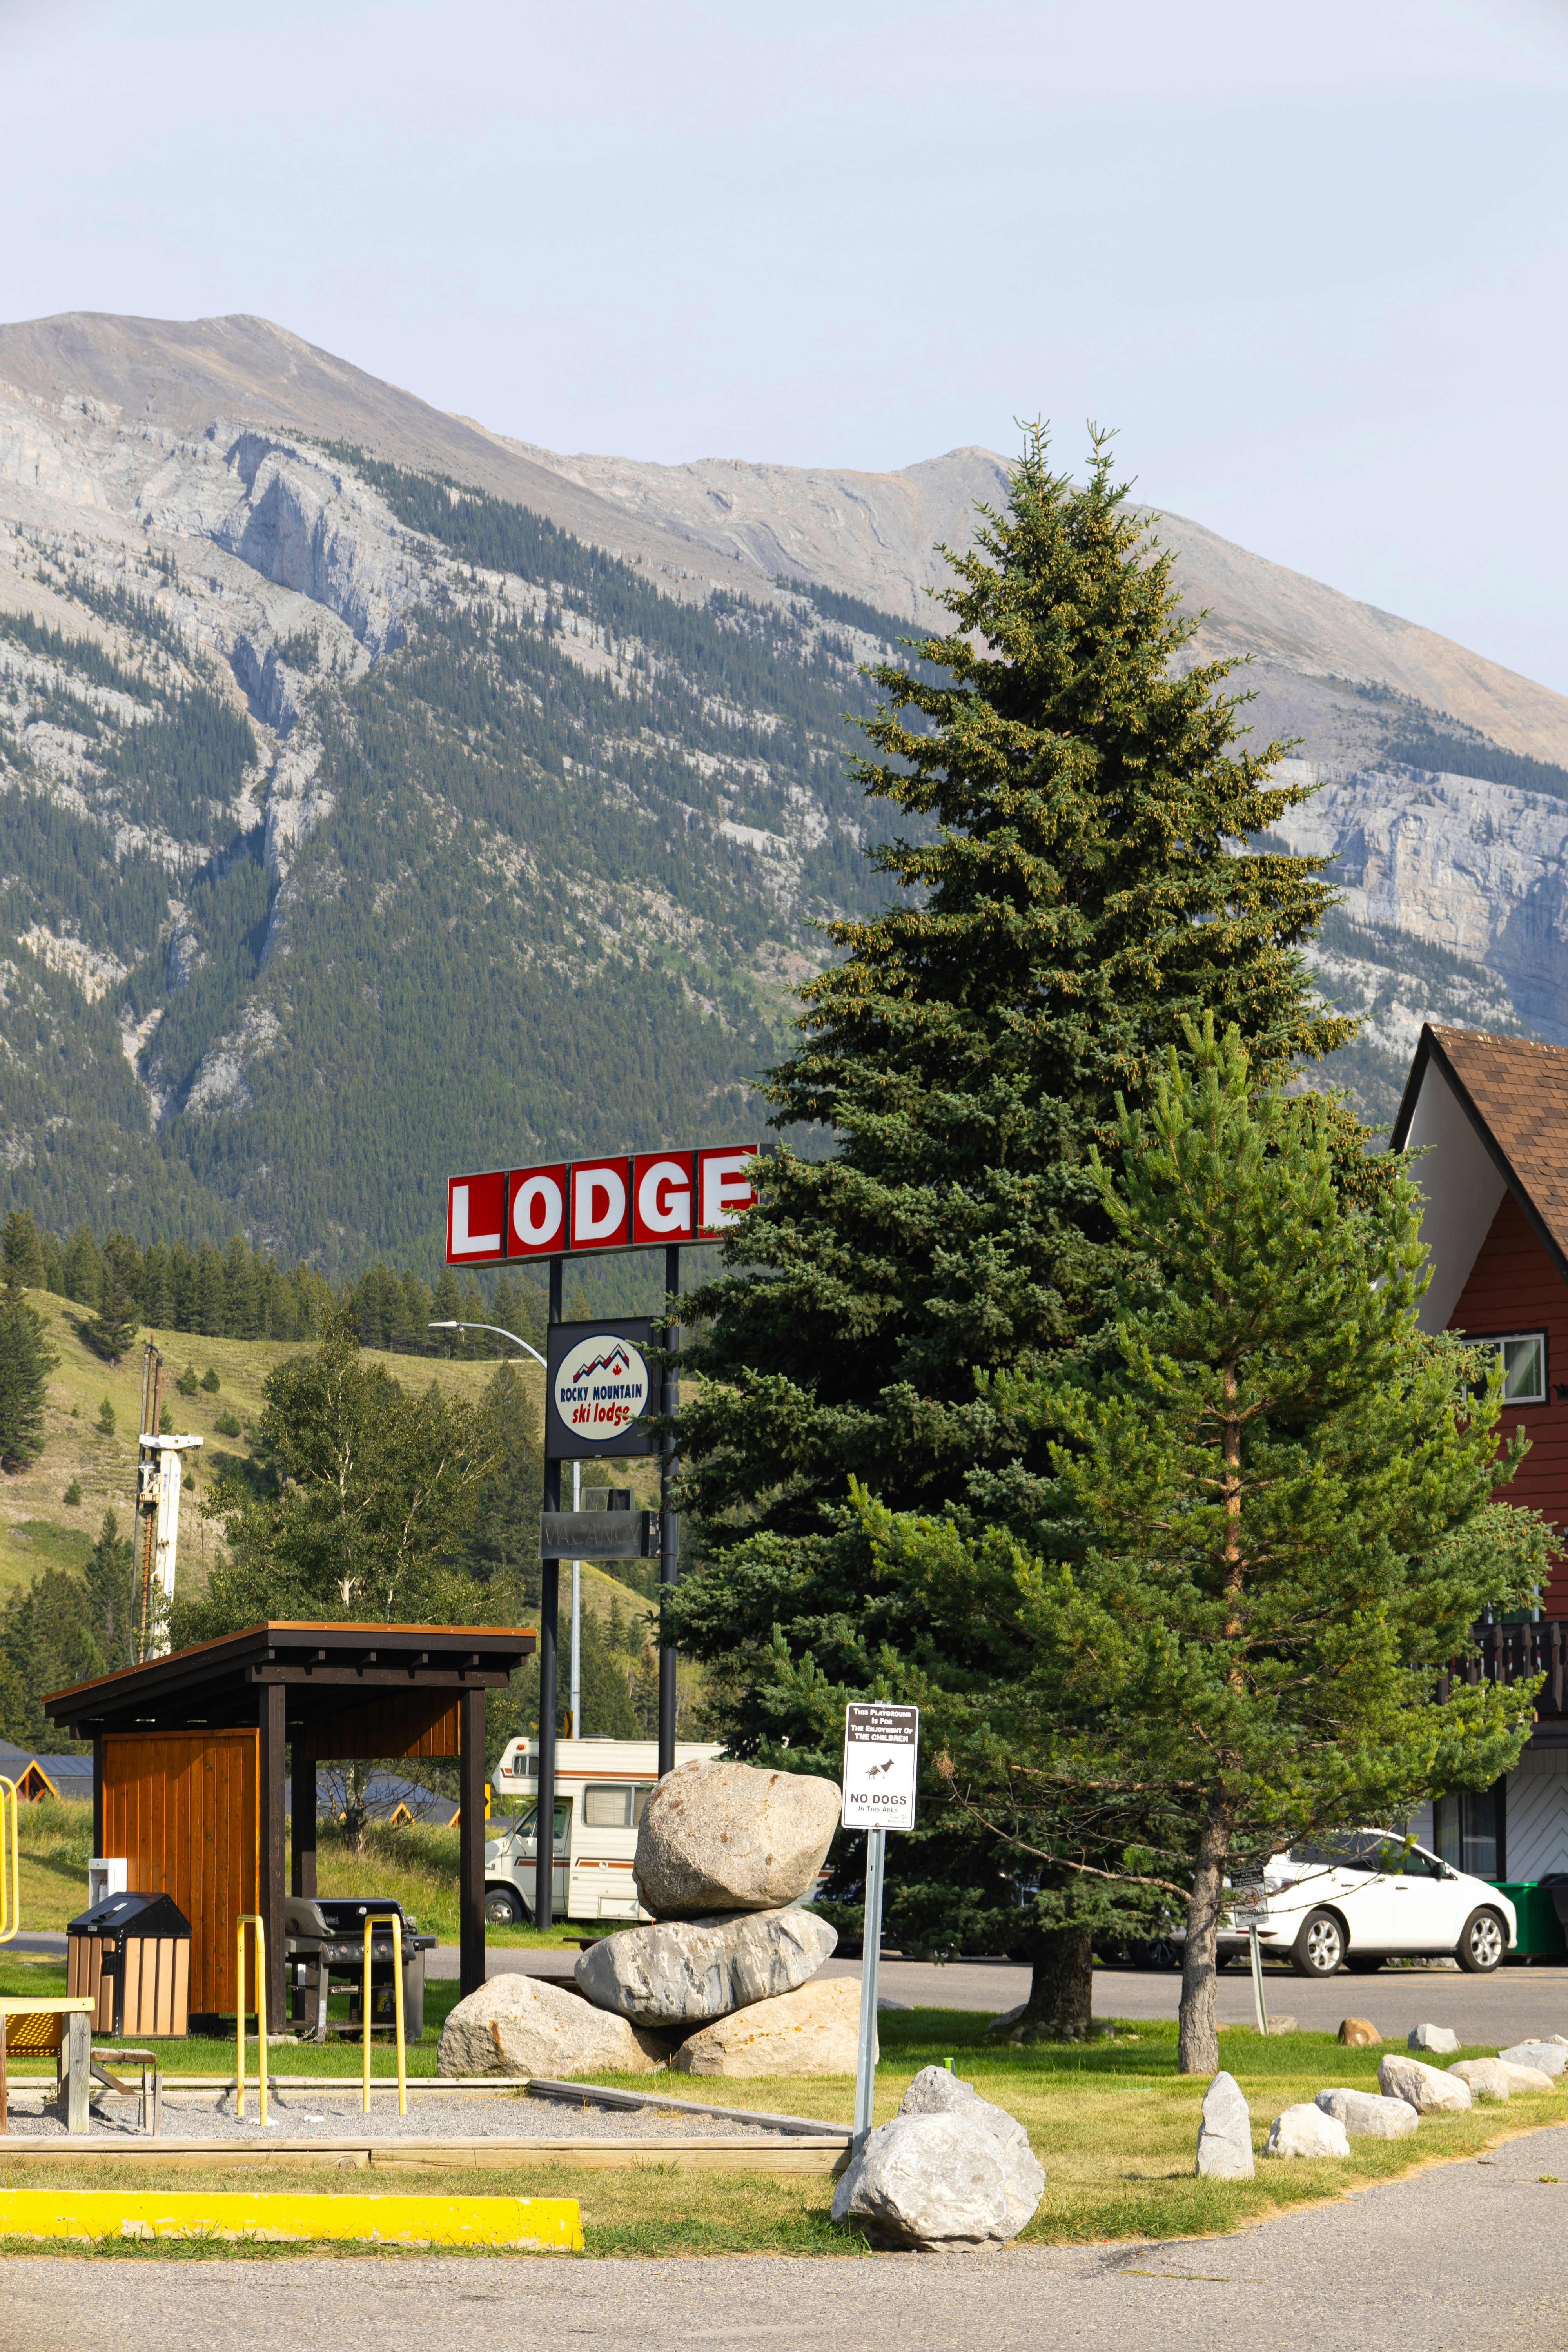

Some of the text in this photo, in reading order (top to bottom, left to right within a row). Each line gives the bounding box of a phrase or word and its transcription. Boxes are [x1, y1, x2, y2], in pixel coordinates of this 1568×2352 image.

[451, 1155, 752, 1255] LODGE
[561, 1383, 642, 1402] ROCKY MOUNTAIN
[572, 1401, 630, 1426] ski lodge
[545, 1523, 641, 1546] VACANCY
[871, 1734, 909, 1742] CHILDREN
[851, 1793, 906, 1805] NO DOGS
